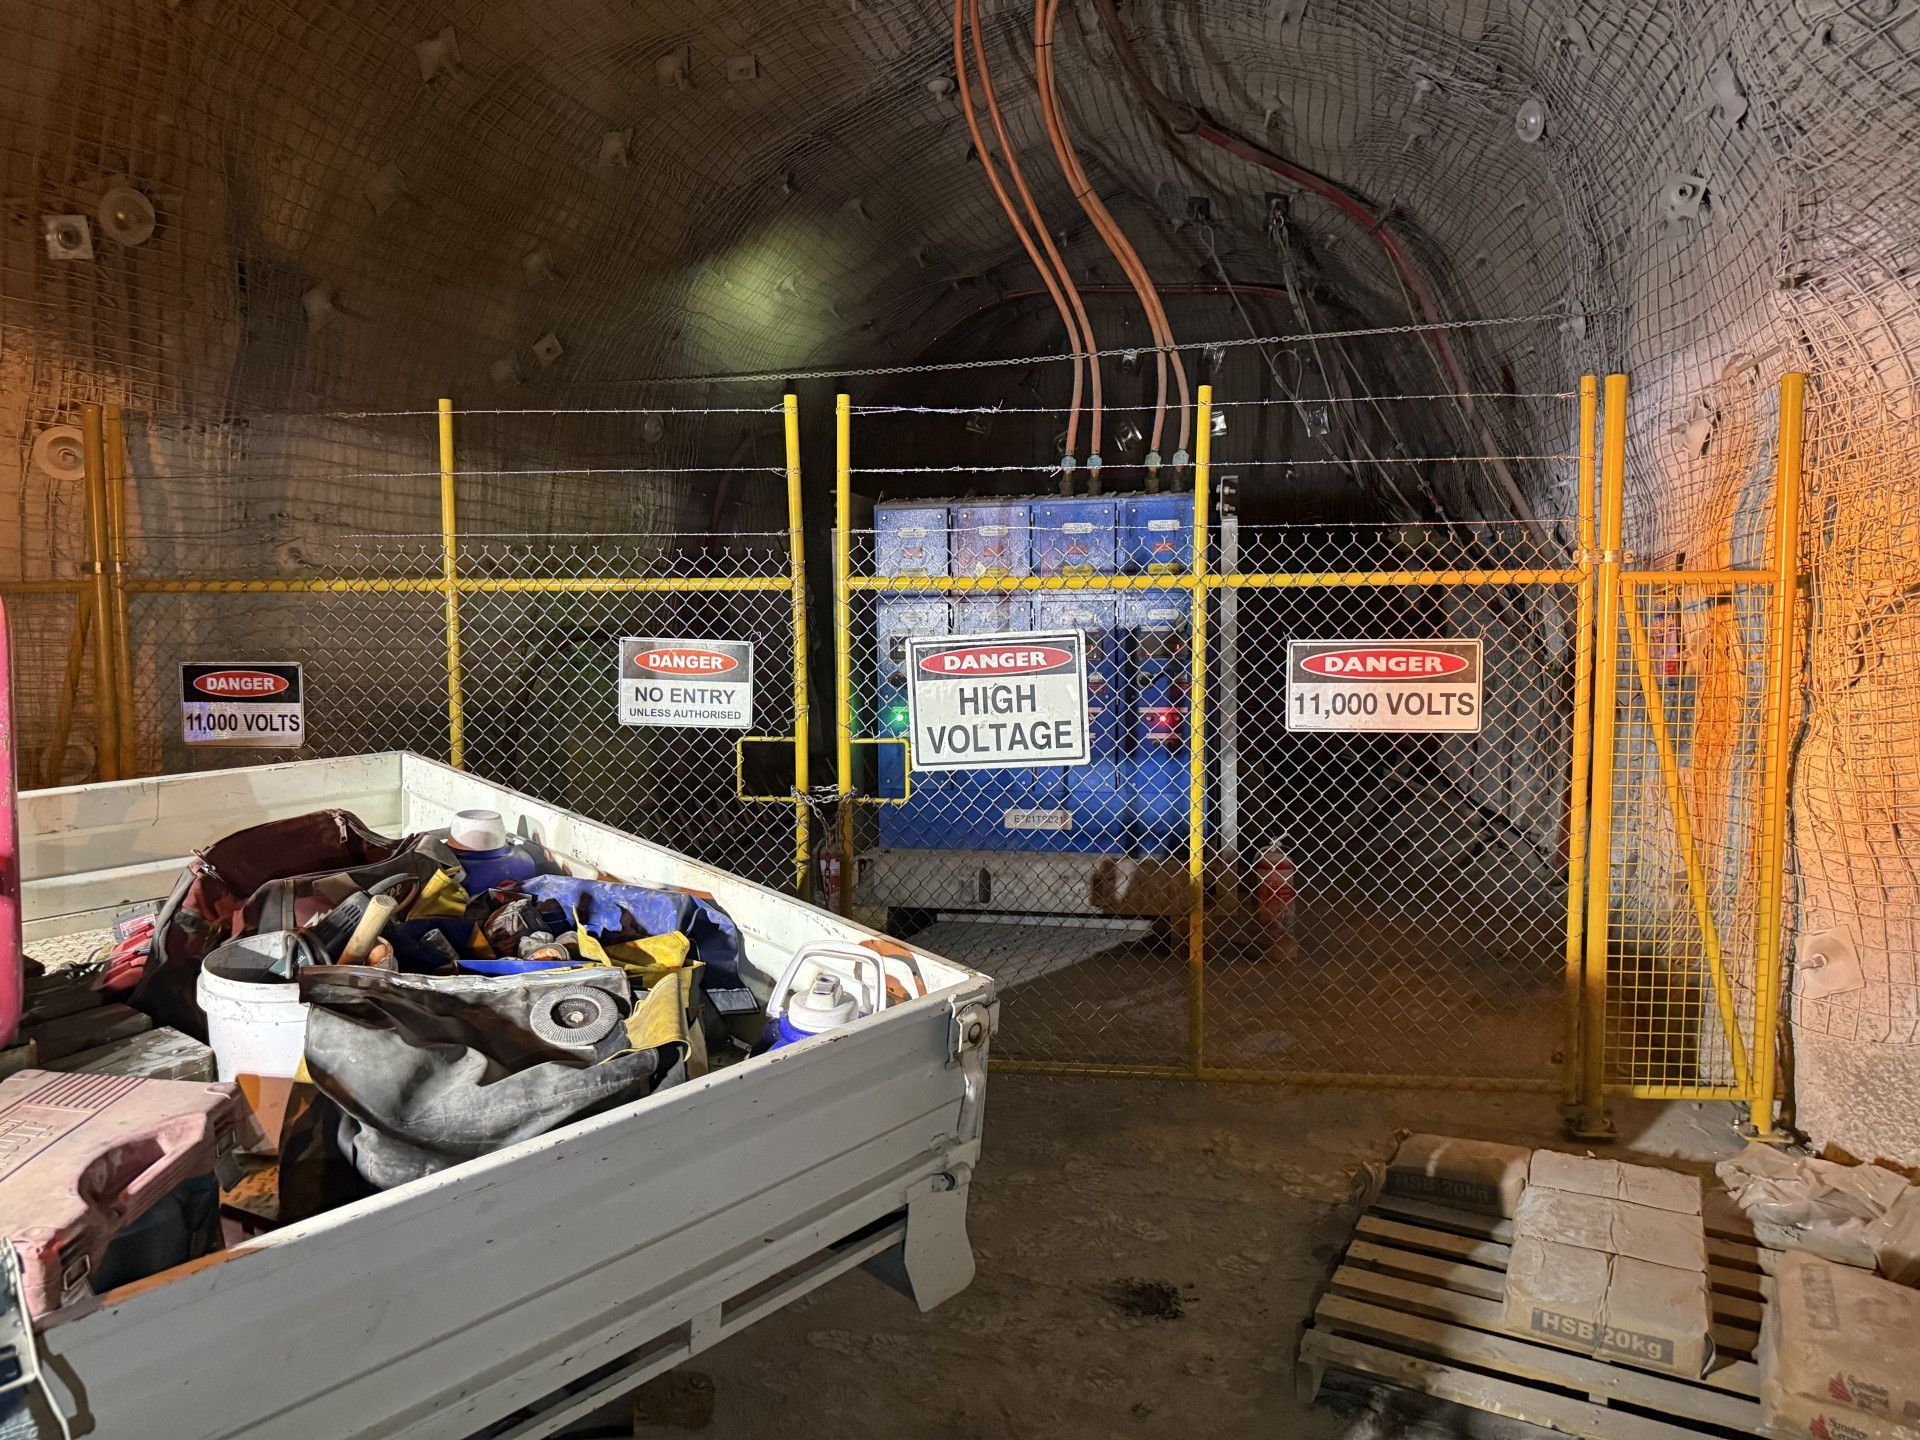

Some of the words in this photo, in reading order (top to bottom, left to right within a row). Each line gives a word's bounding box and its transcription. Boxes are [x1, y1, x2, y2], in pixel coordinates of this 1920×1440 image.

[648, 653, 724, 670] DANGER
[943, 651, 1048, 671] DANGER
[1323, 656, 1444, 673] DANGER
[206, 677, 275, 691] DANGER
[634, 686, 664, 703] NO
[670, 687, 736, 705] ENTRY
[958, 683, 1037, 716] HIGH
[629, 707, 671, 718] UNLESS
[673, 708, 742, 720] AUTHORISED
[1294, 692, 1378, 720] 11,000
[1385, 692, 1475, 716] VOLTS
[186, 713, 239, 734] 11,000
[243, 713, 300, 732] VOLTS
[926, 720, 1074, 754] VOLTAGE
[1541, 1310, 1595, 1341] HSB
[1602, 1326, 1663, 1361] 20kg
